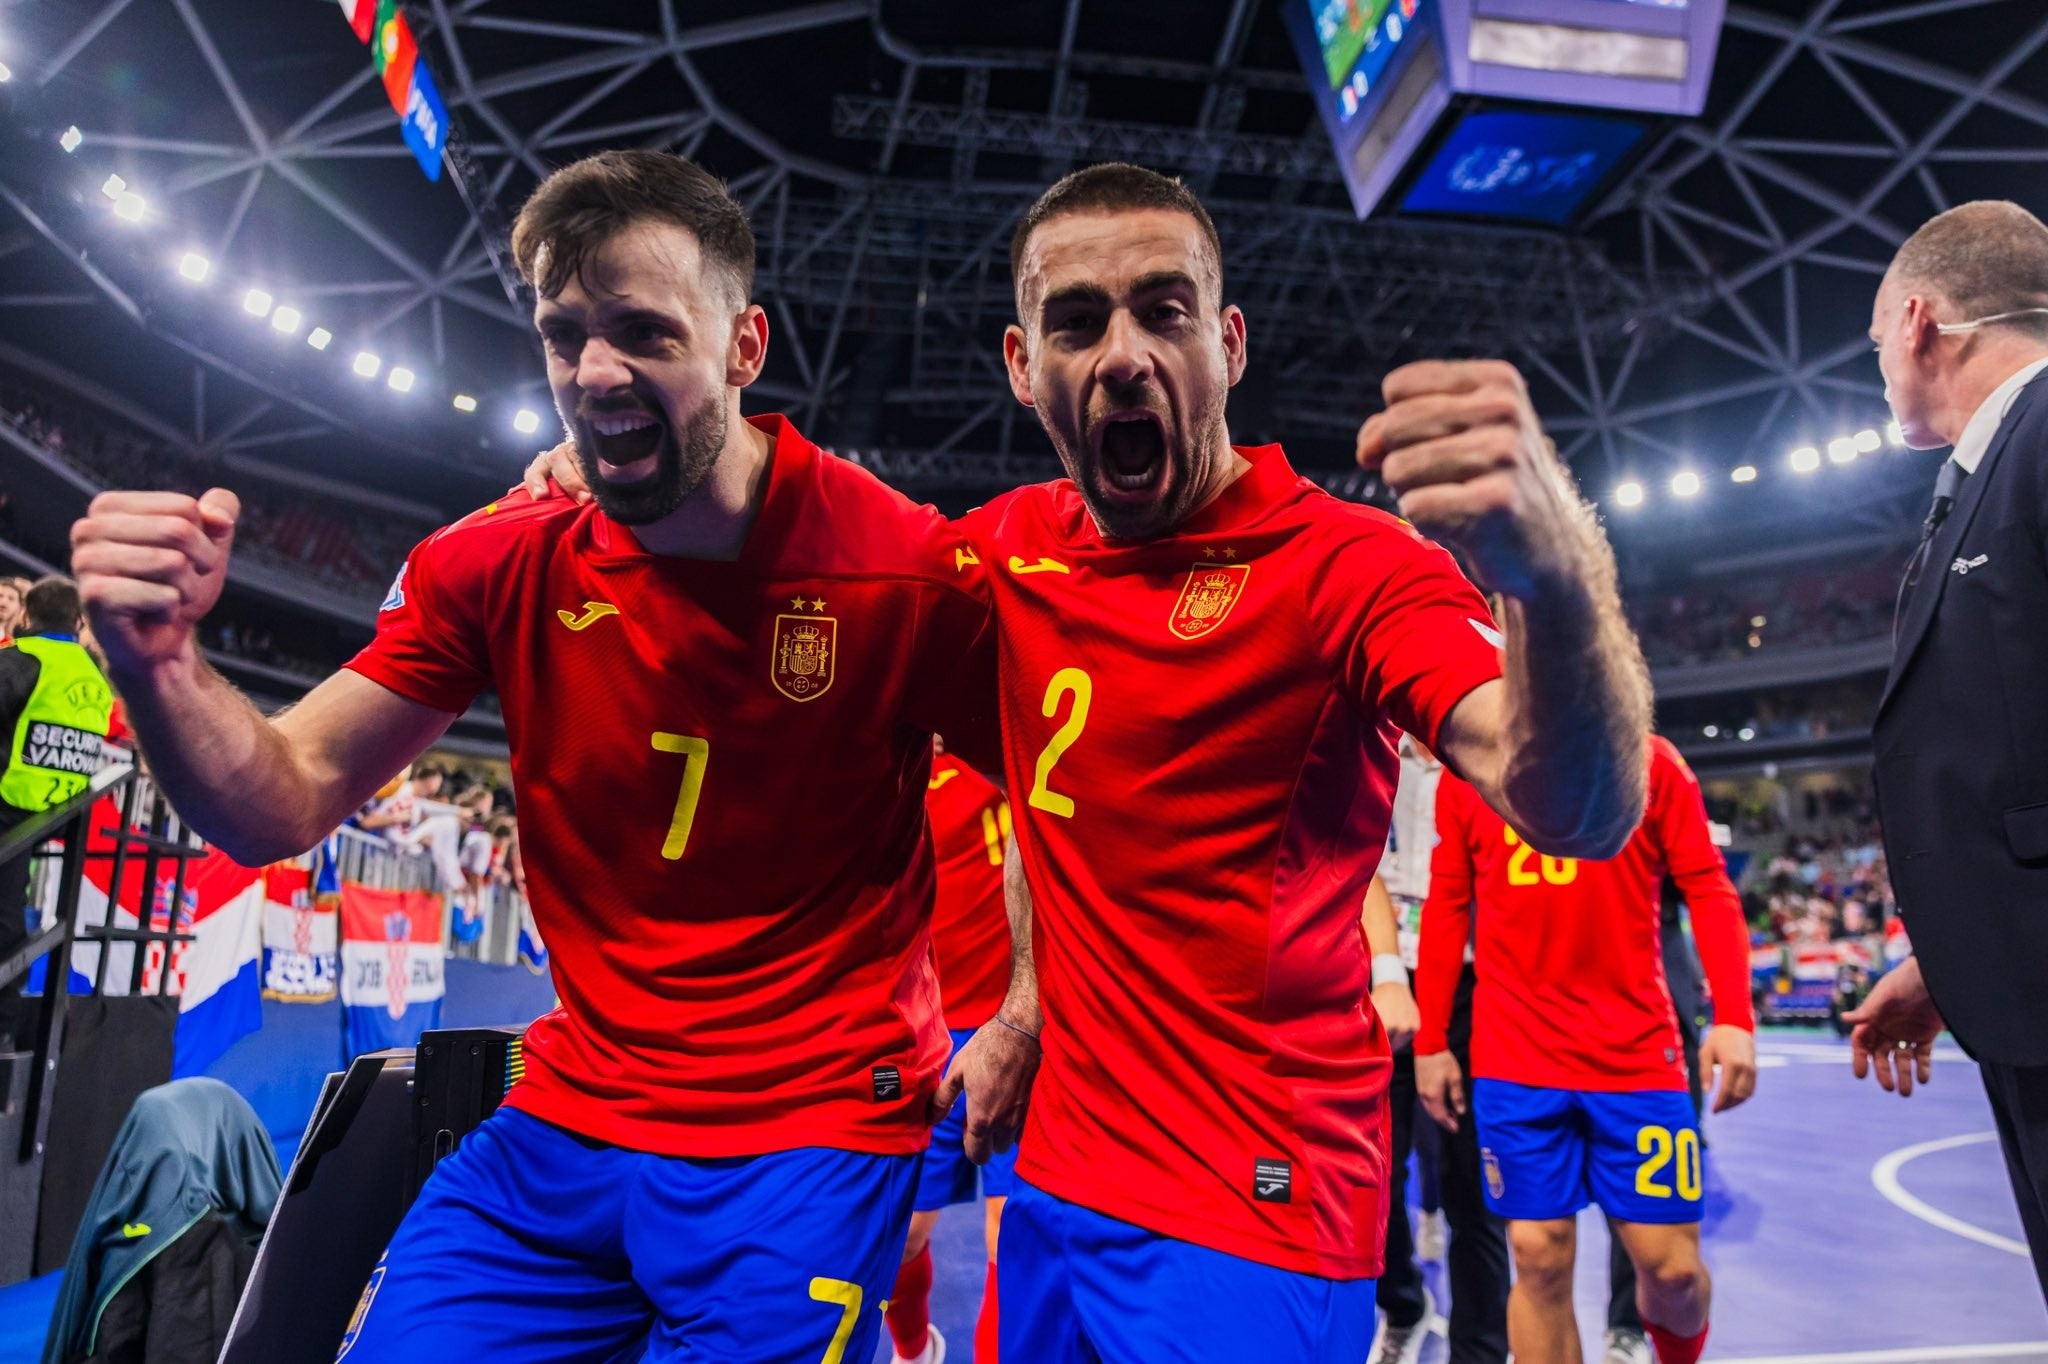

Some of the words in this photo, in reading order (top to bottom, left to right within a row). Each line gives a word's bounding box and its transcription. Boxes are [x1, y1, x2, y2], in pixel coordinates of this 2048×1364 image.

[651, 731, 709, 860] 7
[1028, 667, 1093, 819] 2
[1635, 1125, 1703, 1202] 20
[808, 1276, 863, 1364] 7
